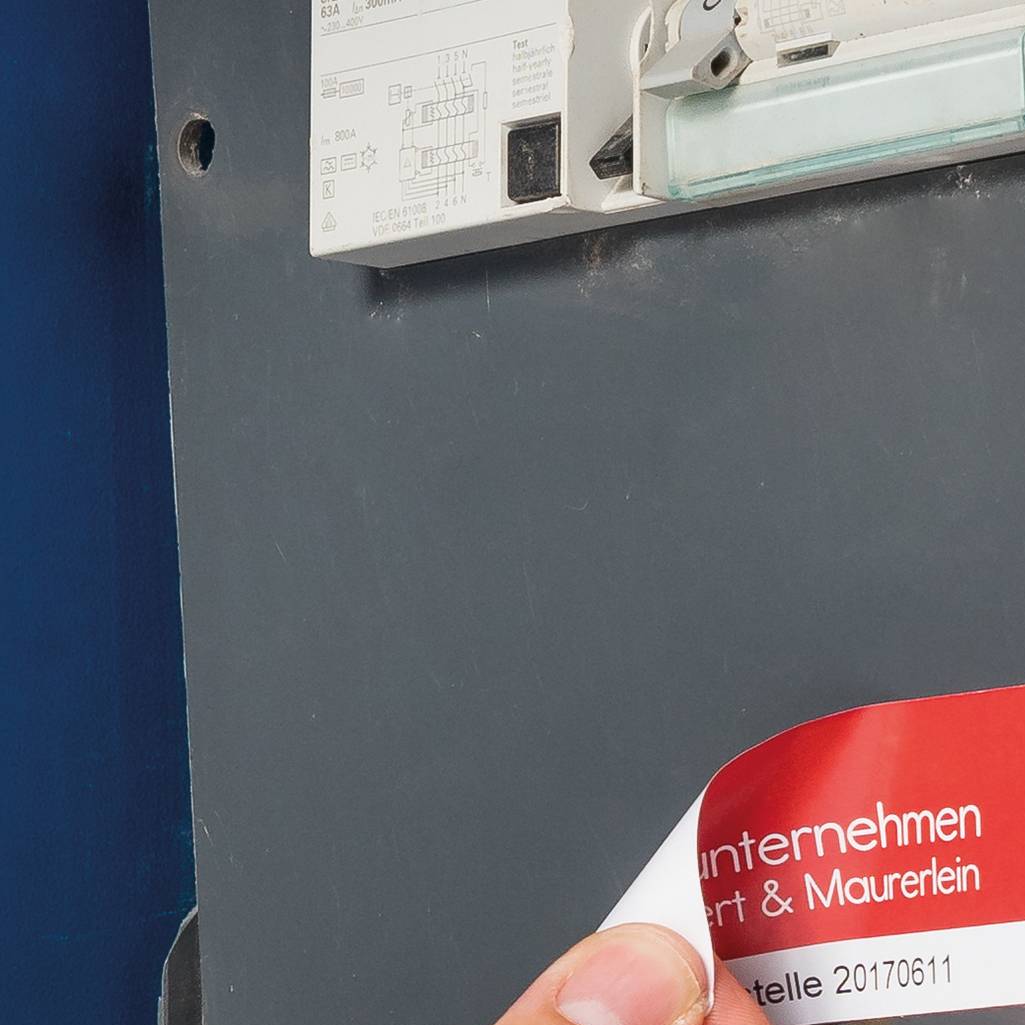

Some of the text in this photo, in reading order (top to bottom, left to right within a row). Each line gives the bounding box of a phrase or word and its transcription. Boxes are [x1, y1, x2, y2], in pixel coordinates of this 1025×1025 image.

[320, 3, 340, 18] 63A
[364, 0, 405, 10] 300m
[513, 39, 529, 50] Test
[334, 128, 356, 142] 800A
[431, 212, 447, 225] 100
[761, 879, 793, 918] &
[804, 856, 980, 910] Maurerlein
[745, 955, 951, 1006] telle 20170611
